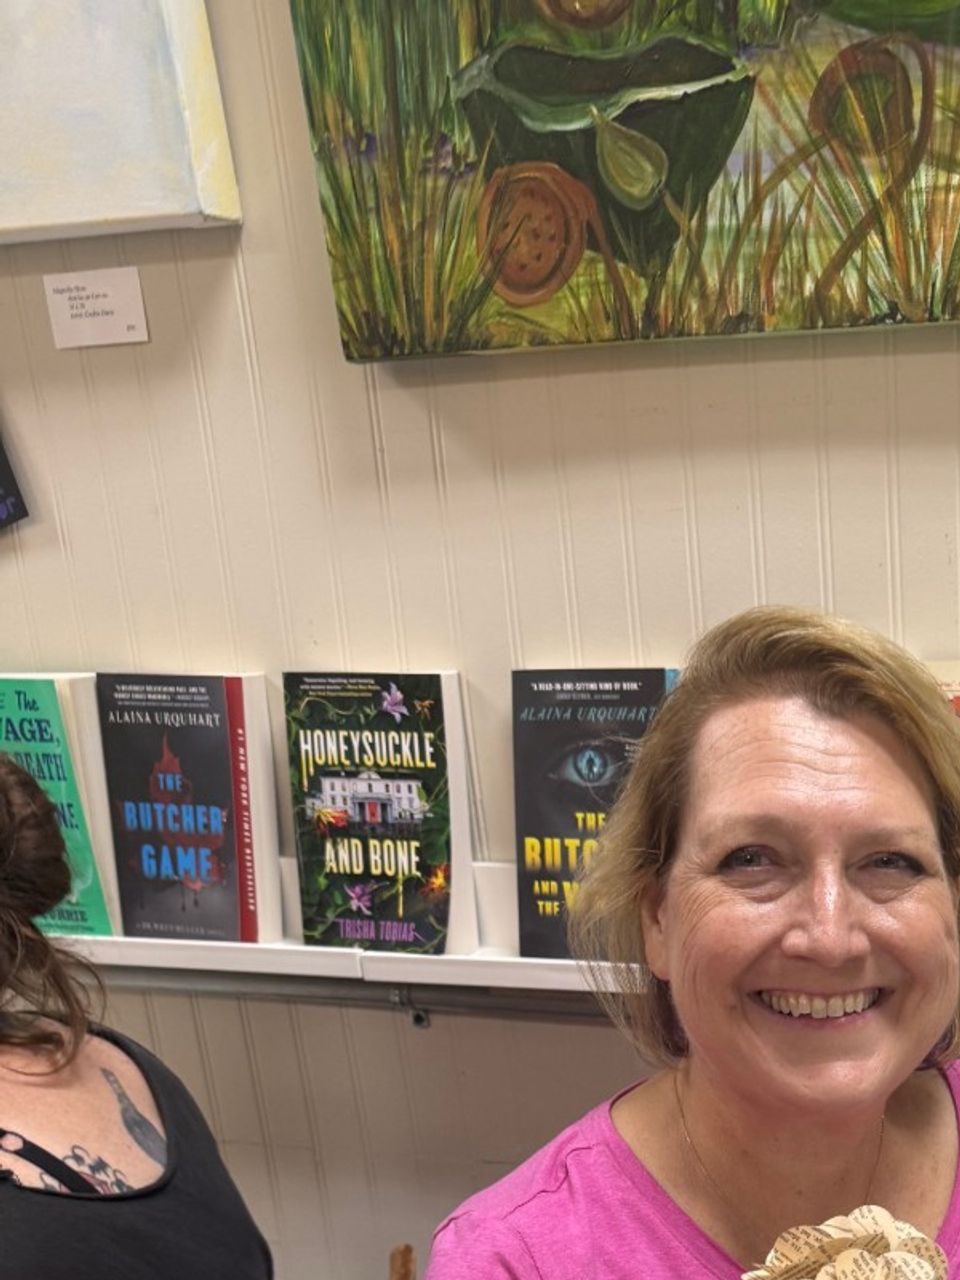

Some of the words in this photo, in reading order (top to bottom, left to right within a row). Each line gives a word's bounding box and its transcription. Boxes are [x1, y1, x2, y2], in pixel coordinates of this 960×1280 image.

[15, 689, 39, 711] The
[108, 710, 152, 724] ALAINA
[155, 711, 221, 727] URQUHART
[519, 706, 572, 721] ALAINA
[0, 717, 60, 747] AGE,
[300, 728, 437, 776] HONEYSUCKLE
[157, 772, 183, 791] THE
[124, 801, 224, 835] BUTCHER
[575, 812, 606, 832] THE
[141, 843, 213, 882] GAME
[325, 838, 364, 875] AND
[368, 838, 421, 882] BONE
[533, 879, 559, 895] AND
[537, 900, 560, 917] THE
[338, 918, 376, 940] TRISHA
[380, 921, 417, 942] TOBIAS
